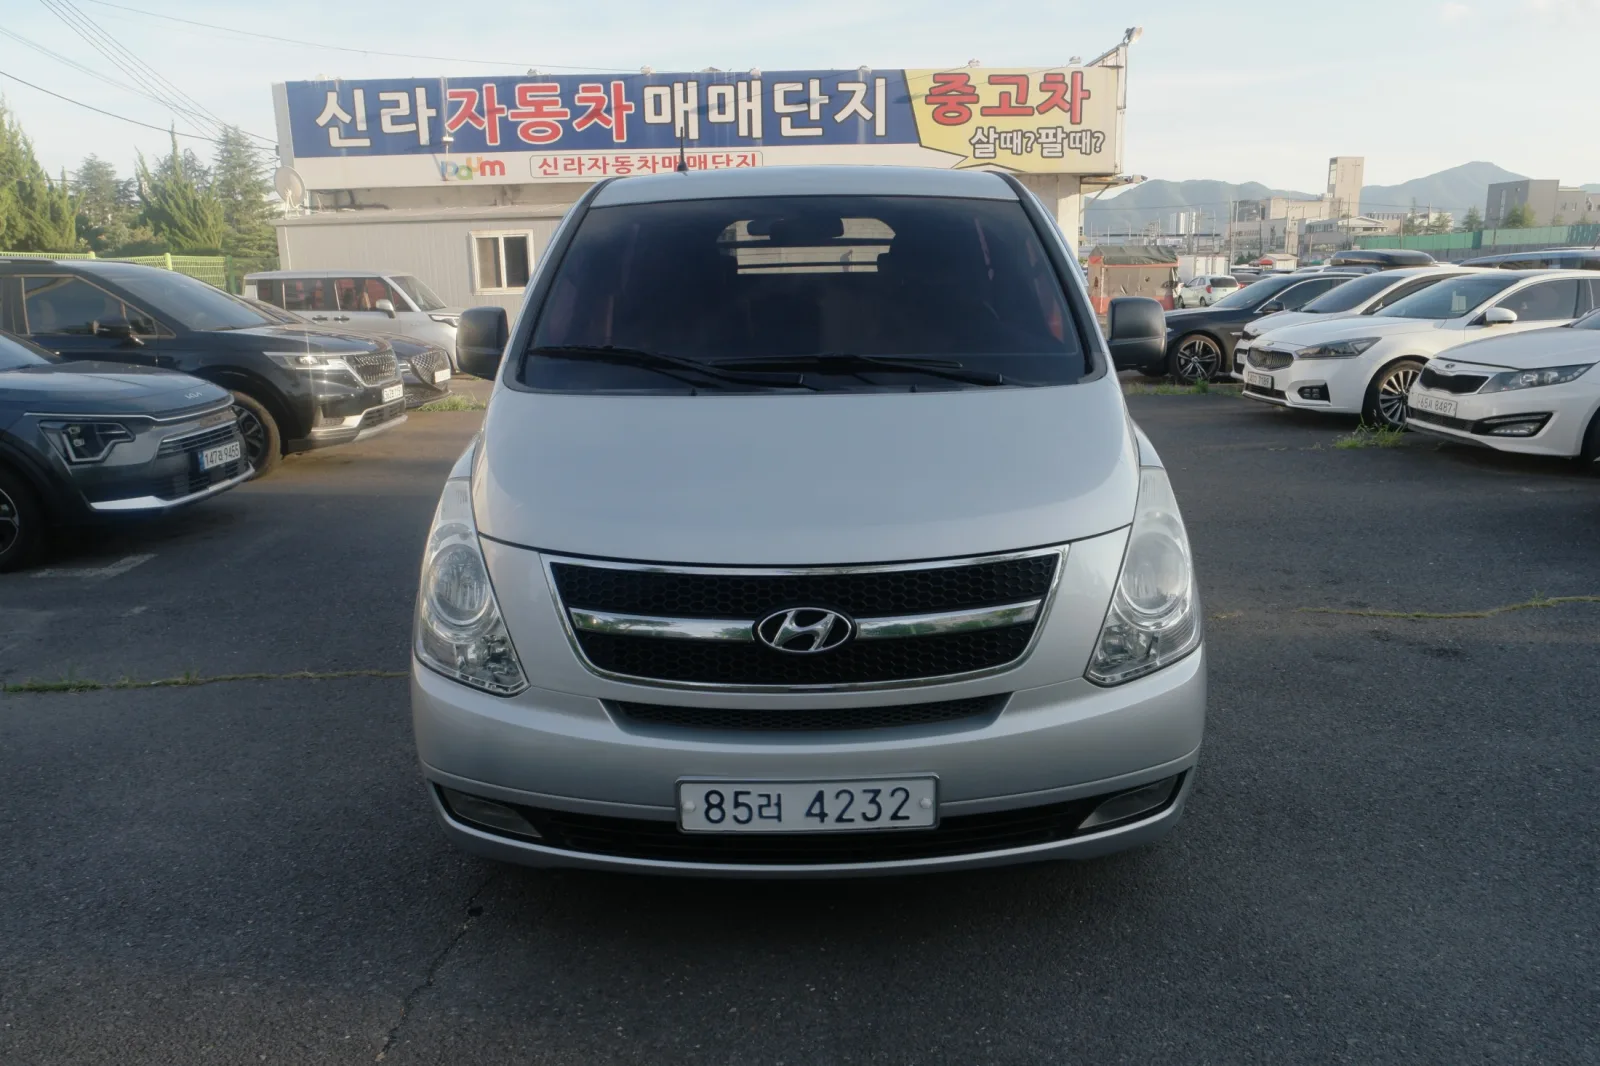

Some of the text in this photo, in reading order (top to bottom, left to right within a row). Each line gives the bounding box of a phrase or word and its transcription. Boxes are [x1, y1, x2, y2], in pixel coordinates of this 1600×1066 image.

[925, 71, 1091, 127] 중고차
[704, 786, 911, 824] 85러 4232
